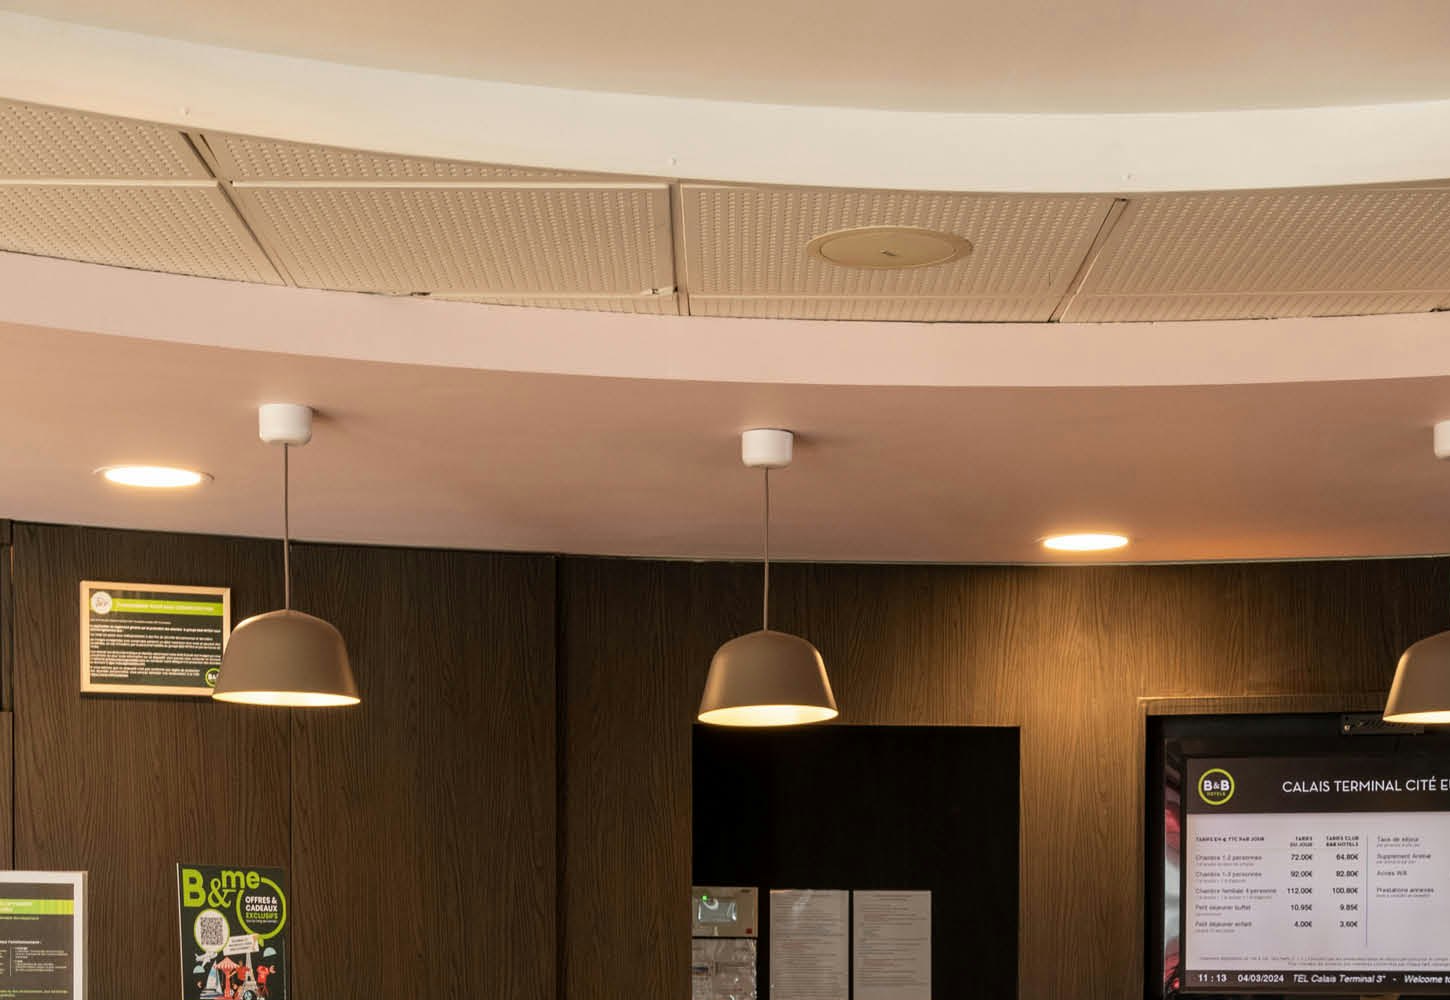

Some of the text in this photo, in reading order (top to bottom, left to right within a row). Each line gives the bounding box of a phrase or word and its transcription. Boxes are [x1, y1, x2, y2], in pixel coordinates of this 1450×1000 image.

[1203, 780, 1230, 792] B&B
[1282, 780, 1330, 793] CALAIS
[1333, 779, 1403, 793] TERMINAL
[1405, 776, 1437, 792] CITÉ
[245, 896, 278, 904] OFFRES &
[245, 904, 278, 912] CADEAUX
[246, 912, 278, 920] EXCLUSIFS
[1216, 974, 1227, 982] 13
[1237, 974, 1284, 983] 04/03/2024
[1293, 974, 1309, 983] TEL
[1311, 974, 1337, 983] Calais
[1339, 974, 1375, 983] Terminal
[1404, 975, 1443, 984] Welcome
